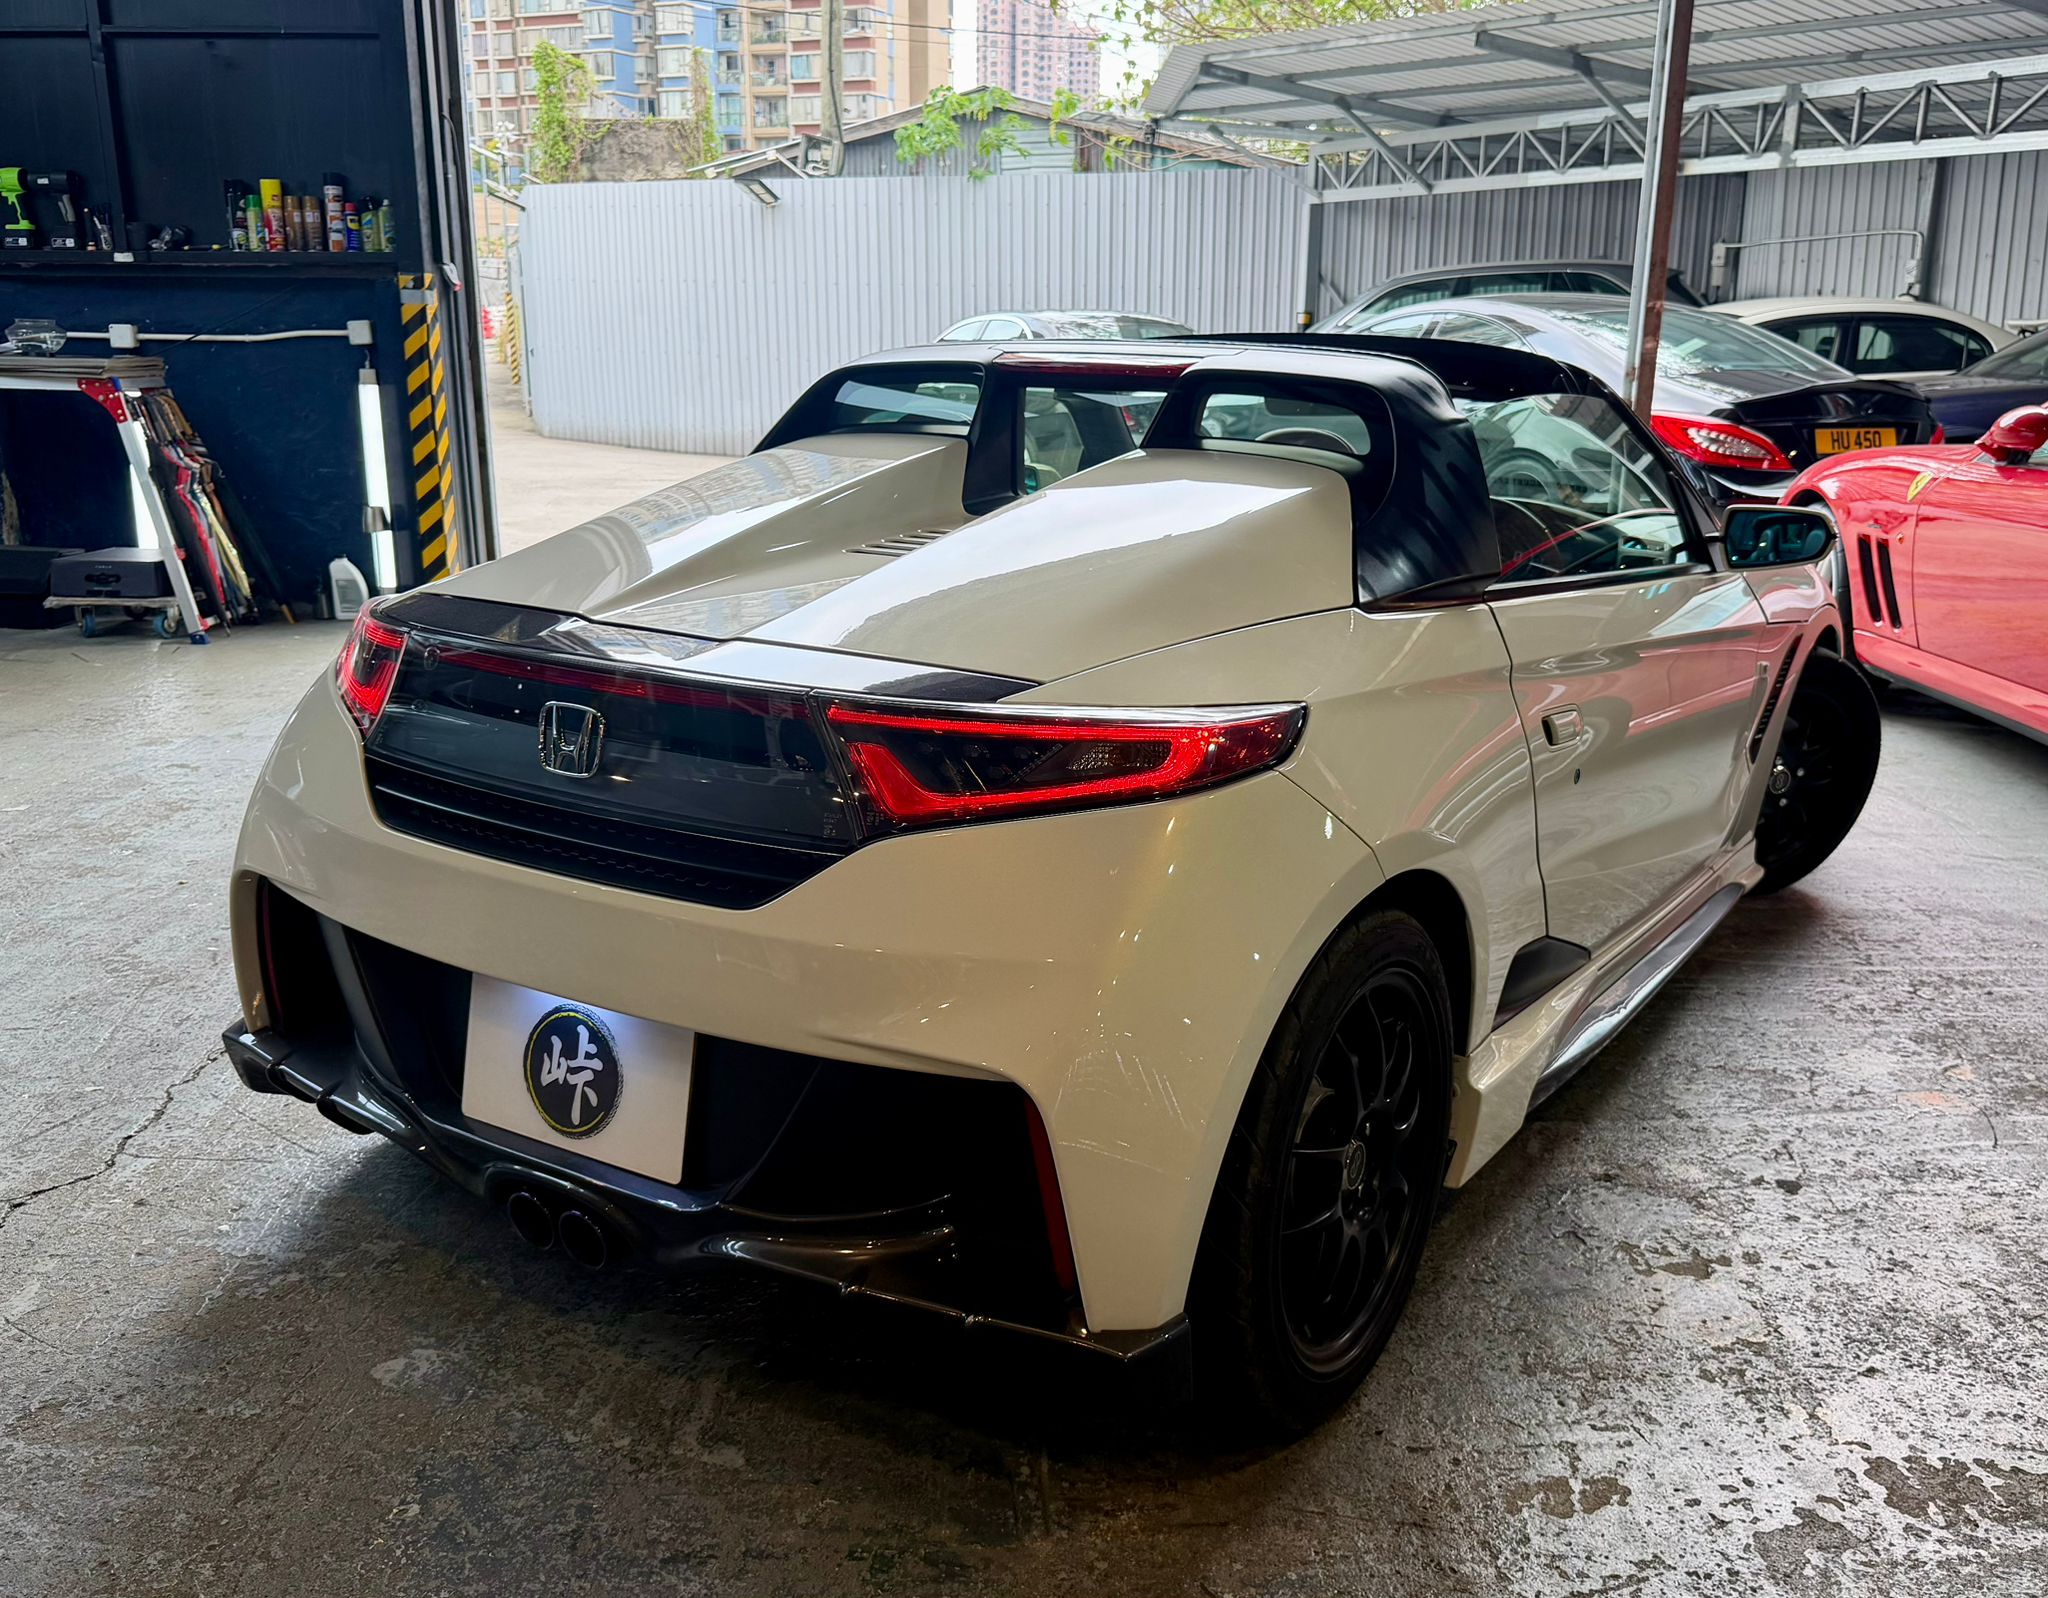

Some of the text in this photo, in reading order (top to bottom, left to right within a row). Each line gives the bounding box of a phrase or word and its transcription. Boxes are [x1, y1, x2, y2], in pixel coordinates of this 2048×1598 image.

[1831, 430, 1882, 450] HU 450
[540, 1024, 604, 1126] 峠
